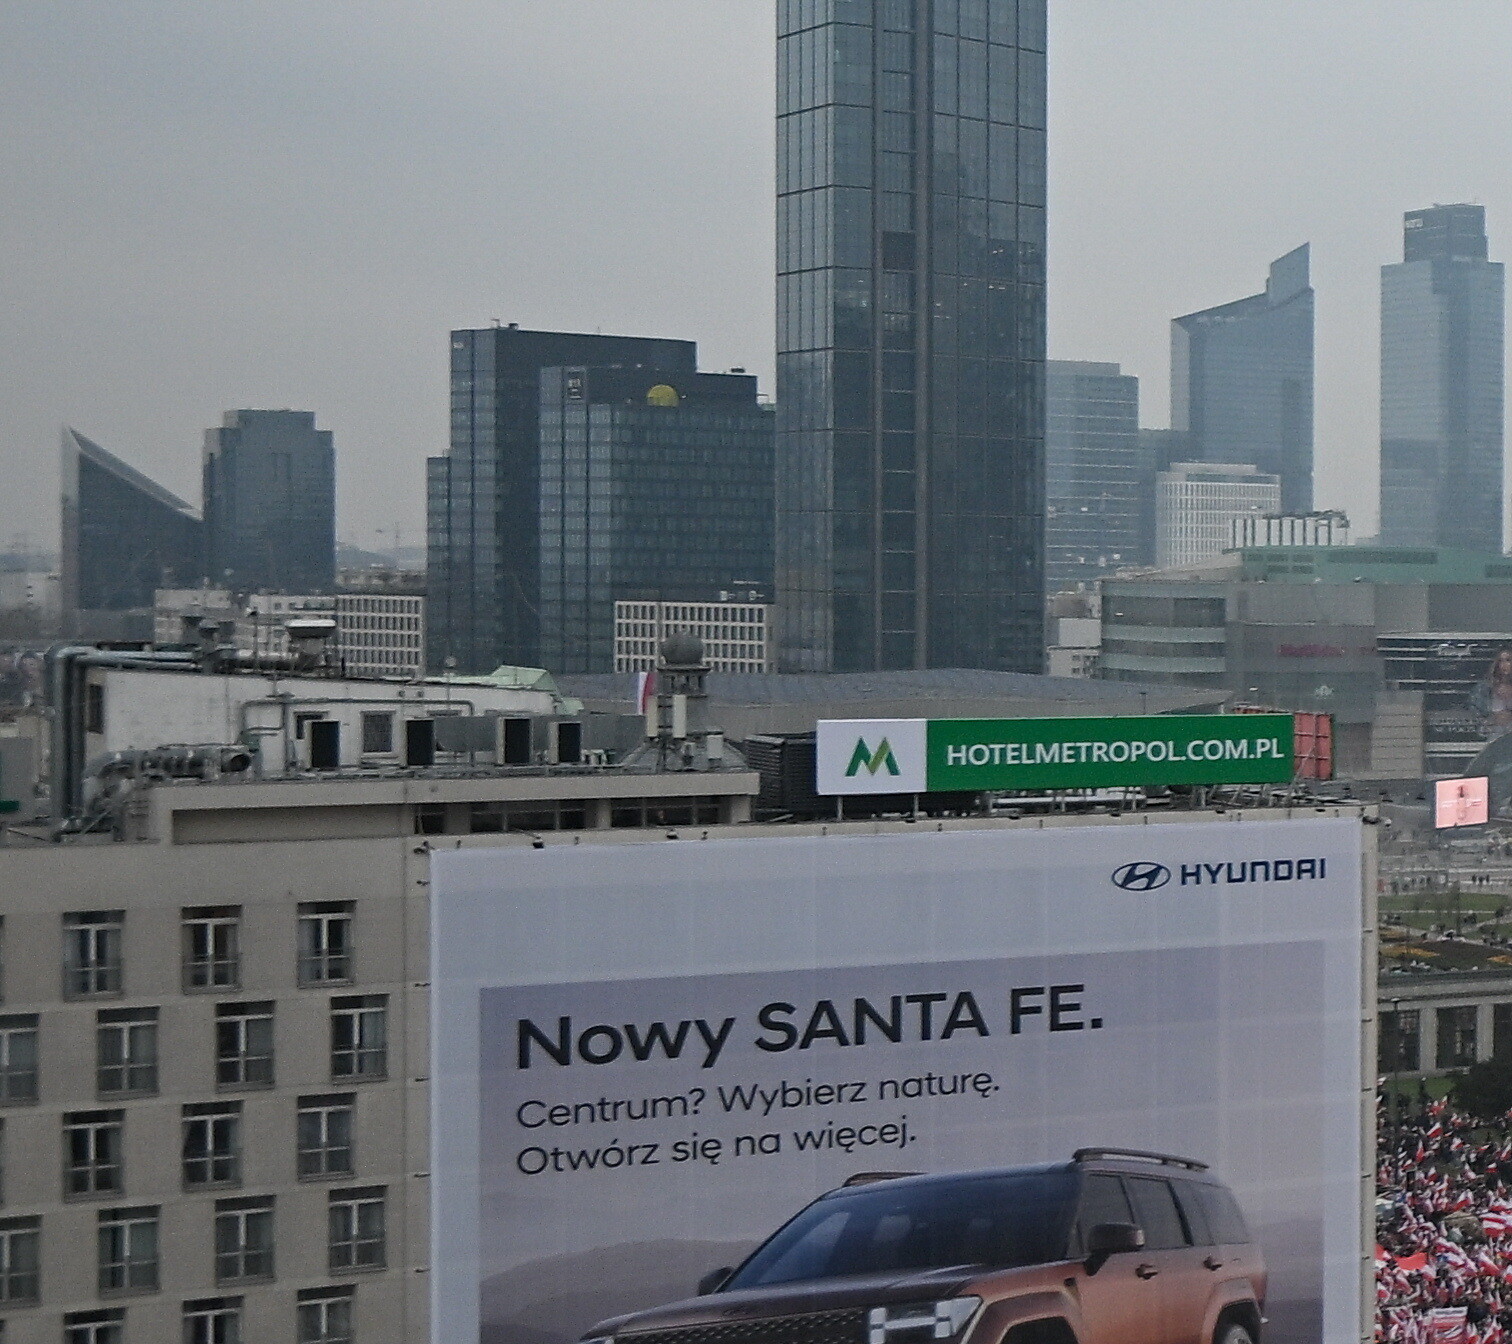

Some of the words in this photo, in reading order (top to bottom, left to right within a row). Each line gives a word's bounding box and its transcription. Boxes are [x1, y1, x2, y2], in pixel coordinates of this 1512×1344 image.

[946, 738, 1285, 766] HOTELMETROPOL.COM.PL
[1181, 858, 1327, 886] HYUNDAI
[517, 1016, 736, 1069] Nowy
[755, 991, 991, 1051] SANTA
[1010, 983, 1105, 1035] FE.
[518, 1087, 706, 1130] Centrum?
[719, 1077, 868, 1121] Wybierz
[879, 1070, 1002, 1103] naturę.
[518, 1141, 660, 1176] Otwórz
[672, 1134, 724, 1164] się
[735, 1137, 783, 1158] na
[795, 1115, 918, 1154] więcej.
